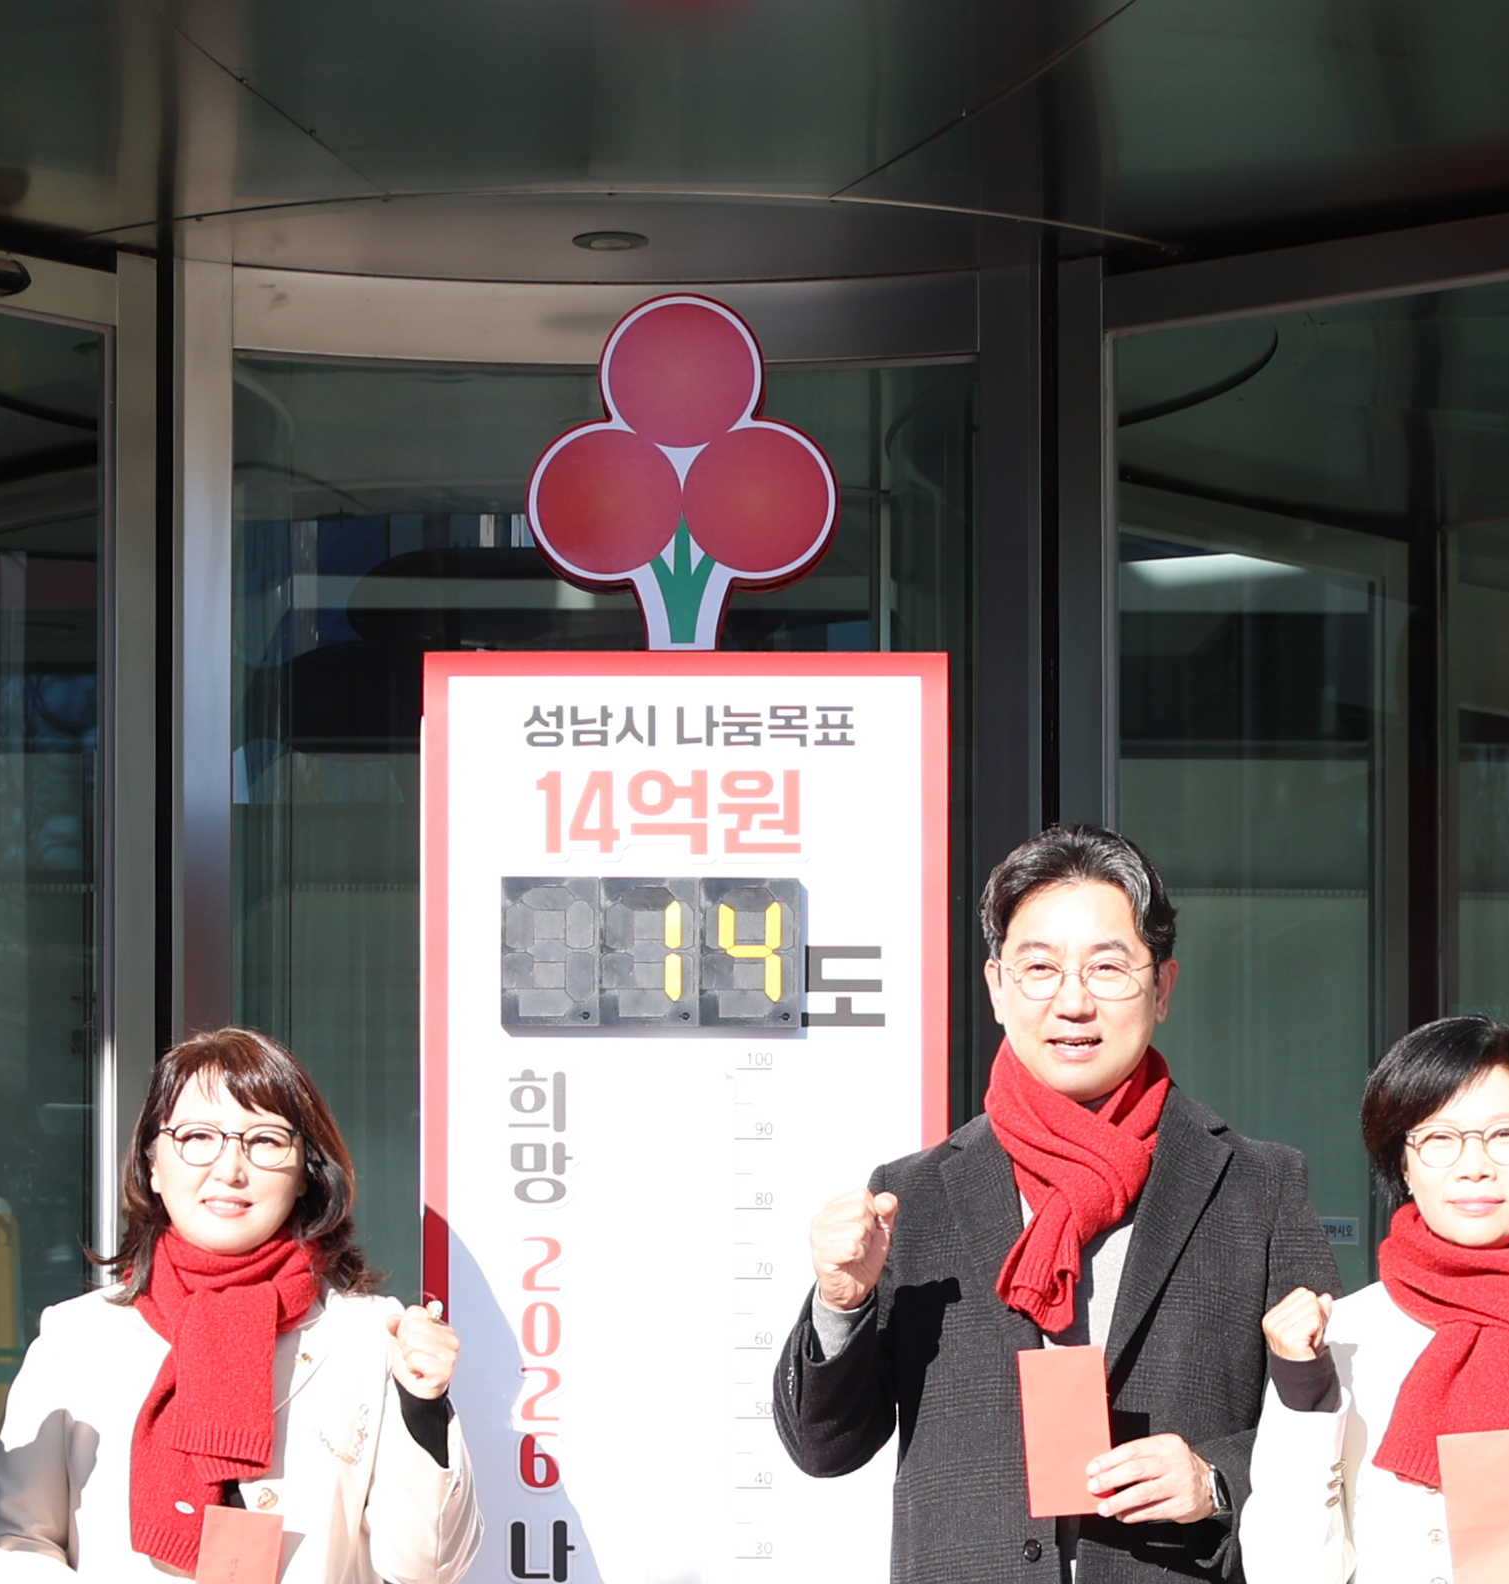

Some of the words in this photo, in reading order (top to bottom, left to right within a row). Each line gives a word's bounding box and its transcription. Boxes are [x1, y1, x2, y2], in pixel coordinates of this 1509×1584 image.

[524, 706, 655, 746] 성남시
[677, 706, 855, 747] 나눔목표
[536, 769, 802, 855] 14억원
[664, 900, 783, 1002] 14
[801, 945, 886, 1027] 도
[746, 1052, 773, 1065] 100
[756, 1123, 772, 1135] 90
[508, 1068, 573, 1205] 희망
[755, 1193, 772, 1205] 80
[758, 1263, 773, 1275] 70
[755, 1333, 772, 1345] 60
[519, 1237, 562, 1489] 2026
[755, 1403, 773, 1415] 50
[755, 1472, 772, 1484] 40
[758, 1543, 772, 1554] 30
